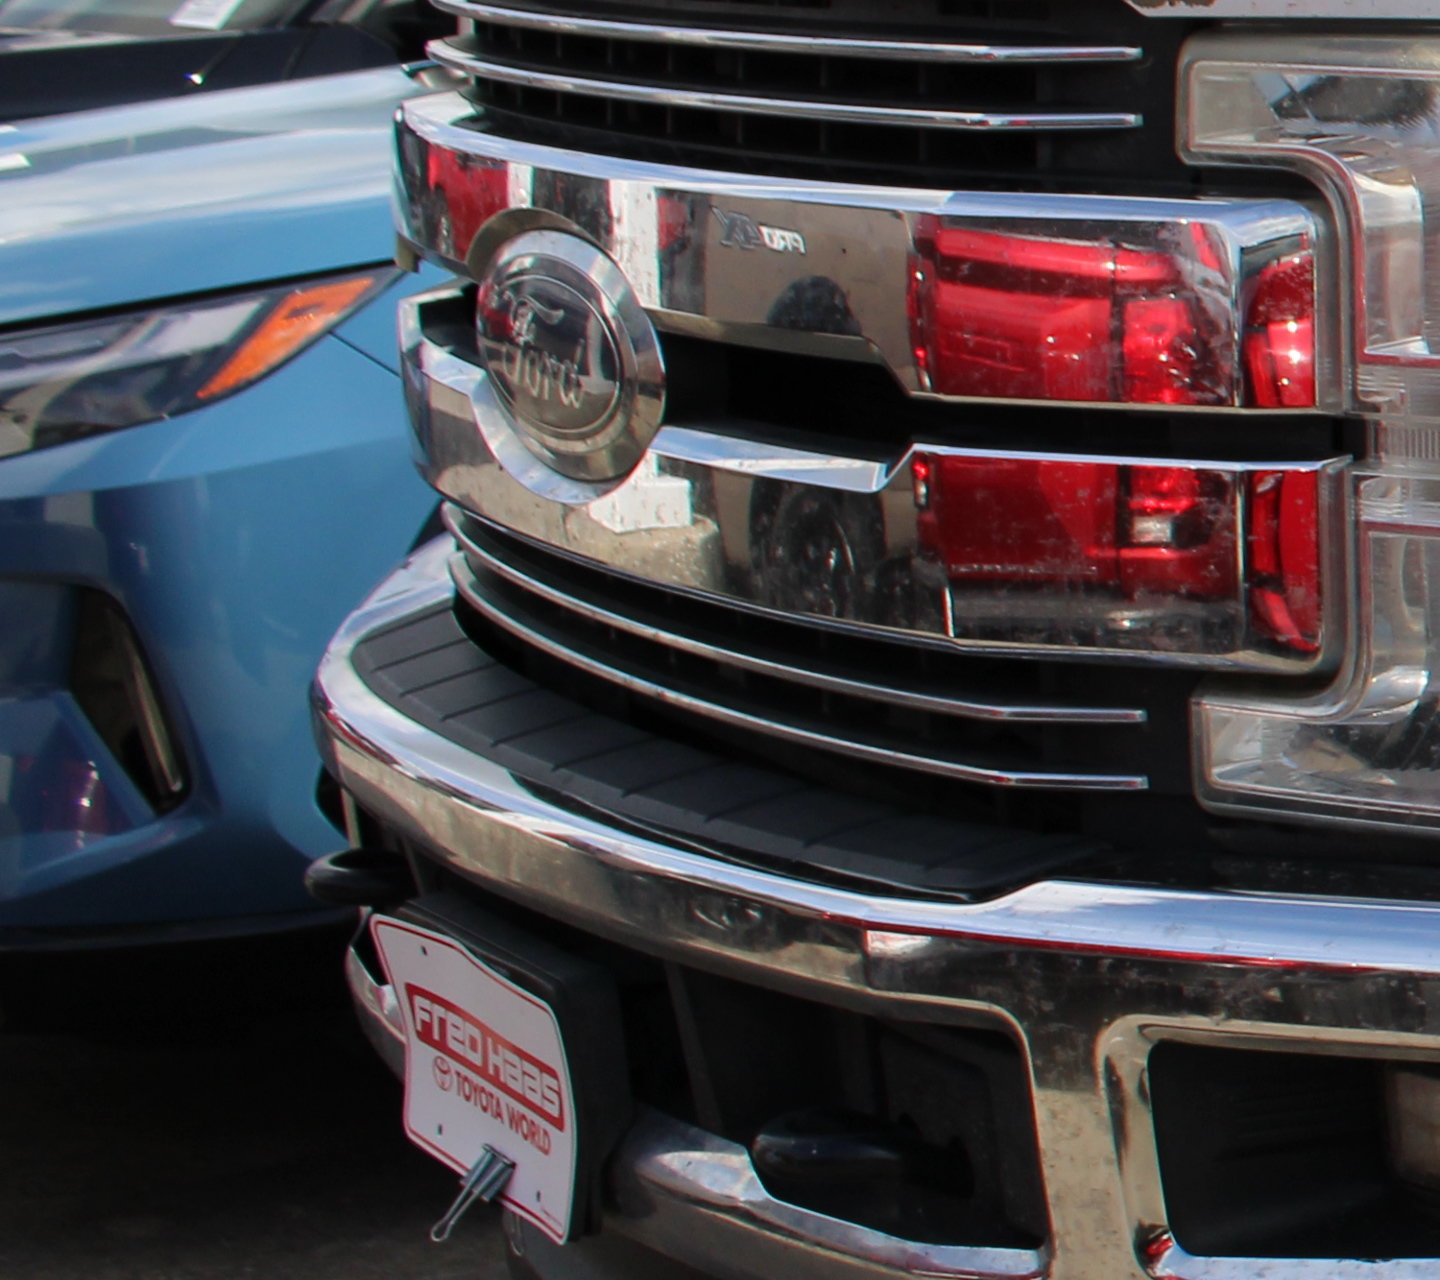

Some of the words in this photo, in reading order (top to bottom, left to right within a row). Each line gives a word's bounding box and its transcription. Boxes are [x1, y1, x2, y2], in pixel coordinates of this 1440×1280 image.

[503, 293, 586, 410] Ford
[454, 1070, 505, 1125] TOYOTA
[508, 1105, 552, 1157] WORLD
